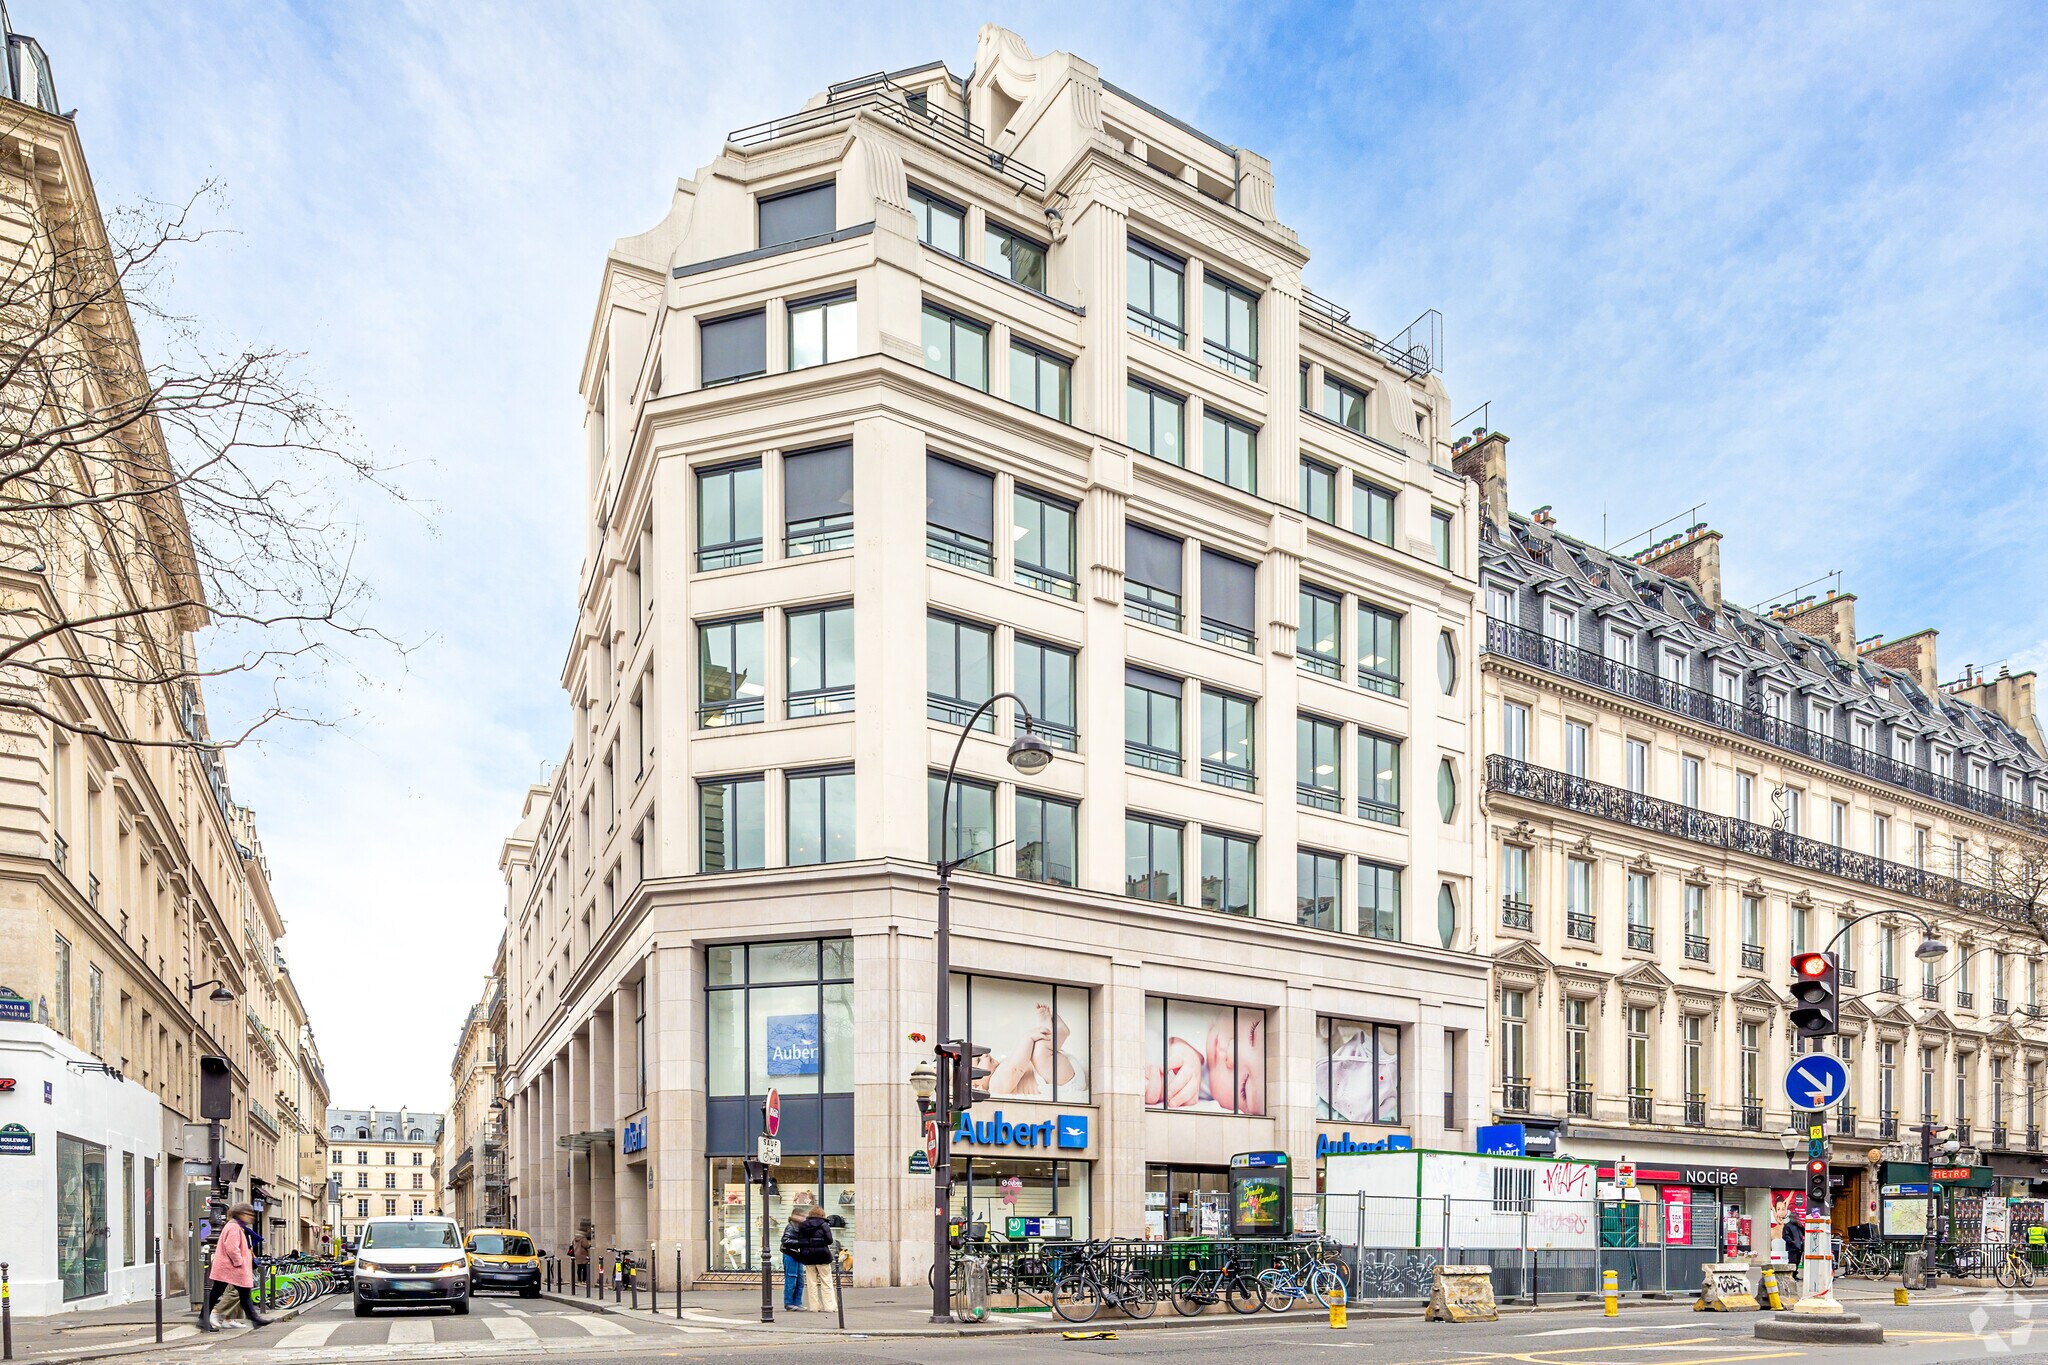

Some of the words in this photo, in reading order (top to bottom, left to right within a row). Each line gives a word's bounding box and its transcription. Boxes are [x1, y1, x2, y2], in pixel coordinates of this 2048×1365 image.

[772, 1044, 818, 1061] Auber
[953, 1111, 1055, 1147] Aubert
[763, 1138, 777, 1147] SAUF
[1934, 1169, 1967, 1179] METRO
